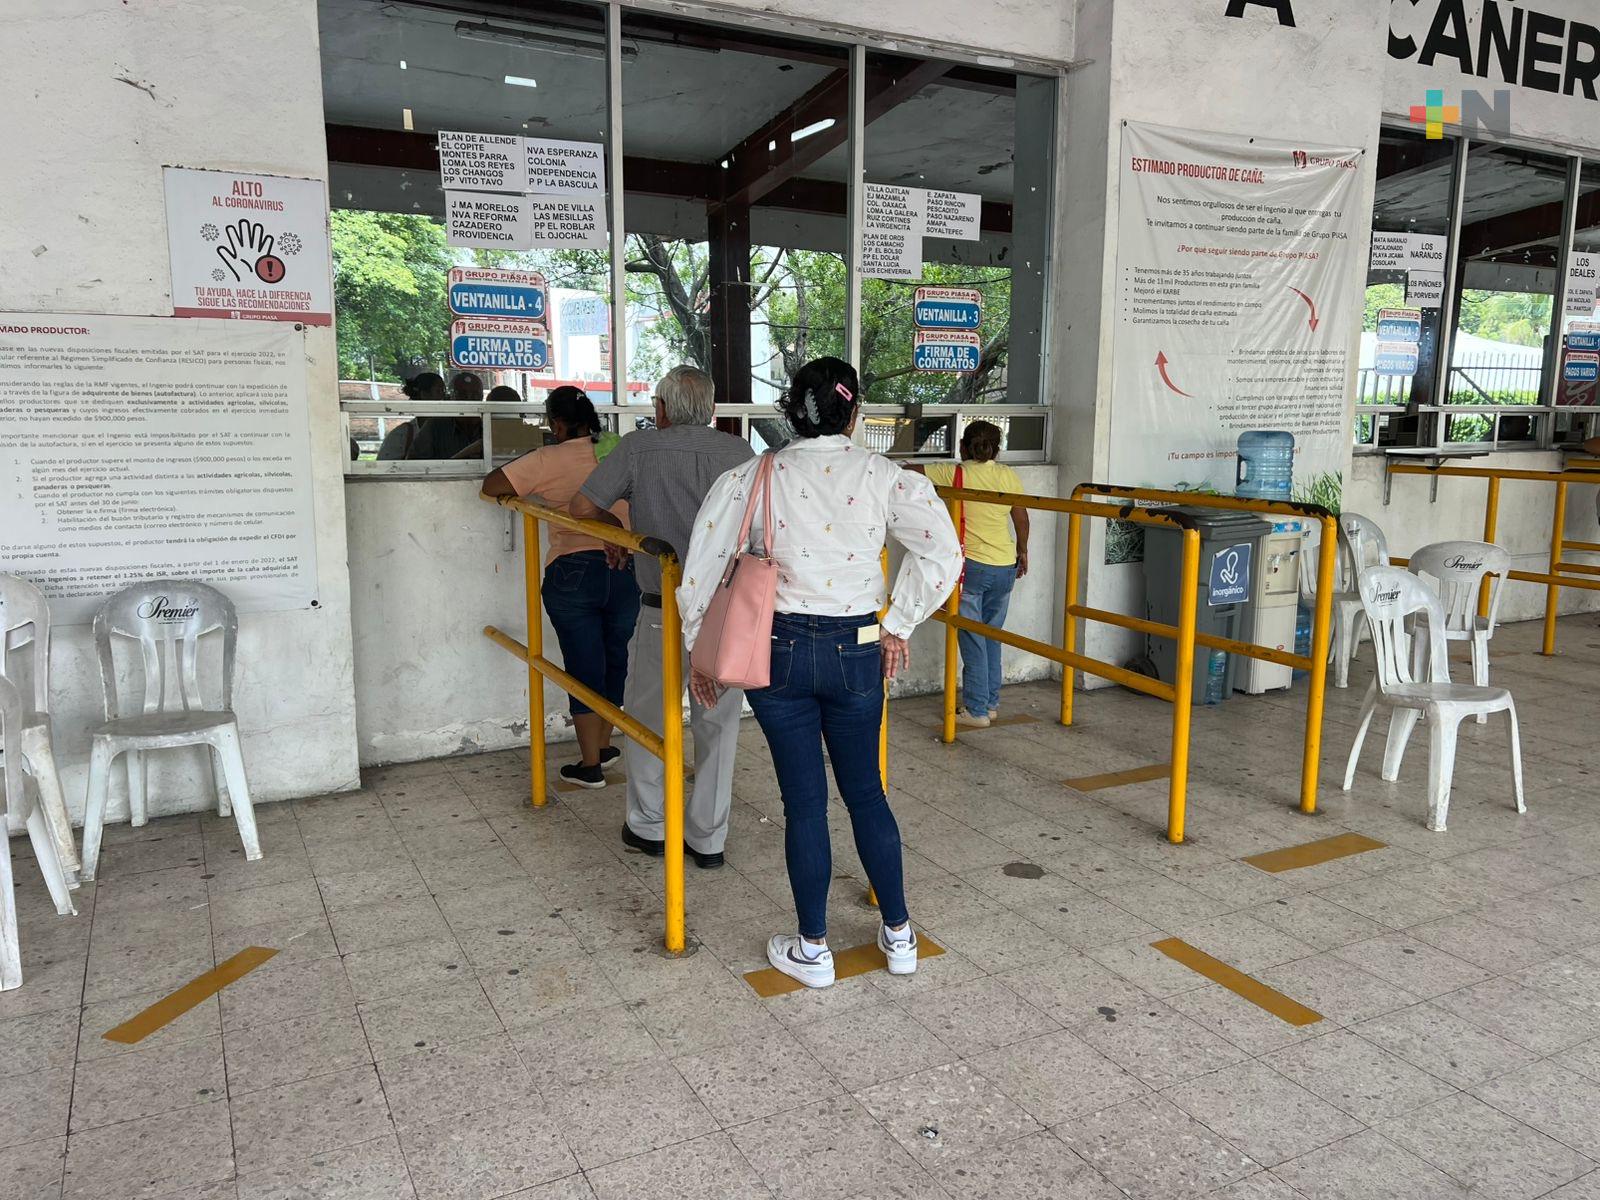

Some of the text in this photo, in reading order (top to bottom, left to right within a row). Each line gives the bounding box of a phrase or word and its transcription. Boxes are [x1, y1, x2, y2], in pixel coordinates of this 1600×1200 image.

[440, 133, 517, 145] PLAN DE ALLENDE
[441, 142, 484, 151] EL COPITE
[442, 151, 508, 161] MONTES PARRA
[527, 147, 598, 159] NVA ESPERANZA
[442, 159, 467, 168] LOMA
[488, 162, 515, 170] REYES
[528, 158, 566, 167] COLONIA
[1309, 157, 1334, 167] GRUPO
[462, 169, 503, 178] CHANGOS
[528, 168, 597, 179] INDEPENDENCIA
[1132, 157, 1265, 184] ESTIMADO PRODUCTOR DE CAÑA:
[459, 177, 478, 185] VITO
[480, 178, 503, 186] TAVO
[537, 178, 542, 186] P
[545, 179, 556, 187] LA
[559, 180, 598, 189] BASCULA
[232, 180, 263, 198] ALTO
[885, 187, 910, 195] OJITLAN
[876, 193, 906, 202] MAZAMILA
[934, 192, 956, 200] ZAPATA
[212, 196, 284, 211] AL CORONAVIRUS
[459, 202, 472, 210] MA
[475, 203, 519, 212] MORELOS
[533, 203, 555, 211] PLAN
[572, 204, 594, 212] VILLA
[882, 201, 907, 209] OAXACA
[944, 200, 966, 208] RINCON
[1157, 195, 1171, 205] Nos
[1172, 197, 1202, 208] sentimos
[1203, 200, 1235, 211] orgullosos
[1237, 201, 1245, 210] de
[895, 209, 918, 217] GALERA
[927, 206, 959, 214] PESCADITO
[452, 210, 517, 222] NVA REFORMA
[534, 212, 593, 221] LAS MESILLAS
[882, 215, 911, 224] CORTINES
[944, 214, 974, 223] NAZARENO
[452, 221, 502, 231] CAZADERO
[560, 222, 595, 231] ROBLAR
[876, 223, 910, 231] VIRGENCITA
[452, 230, 513, 241] PROVIDENCIA
[548, 232, 588, 240] OJOCHAL
[926, 227, 963, 236] SOYALTEPEC
[1177, 245, 1193, 253] ¿Por
[1208, 247, 1228, 255] seguir
[1410, 251, 1442, 260] NARANJOS
[1576, 258, 1590, 267] LOS
[465, 271, 498, 279] GRUPO
[501, 272, 528, 281] PIASA
[195, 286, 311, 301] TU AYUDA, HACE LA DIFERENCIA
[197, 297, 310, 310] SIGUE LAS RECOMENDACIONES
[453, 292, 542, 311] VENTANILLA 4
[917, 308, 978, 323] VENTANILLA 3
[30, 326, 90, 335] PRODUCTOR:
[468, 323, 500, 331] GRUPO
[503, 324, 530, 332] PIASA
[468, 337, 533, 353] FIRMA DE
[925, 346, 969, 358] FIRMA DE
[459, 351, 542, 367] CONTRATOS
[918, 358, 975, 369] CONTRATOS
[1566, 367, 1596, 377] PAGOS VARIOS
[1443, 555, 1483, 569] Premier
[1213, 585, 1244, 597] inorgánico
[1369, 582, 1401, 604] Premier
[137, 596, 199, 619] Premier
